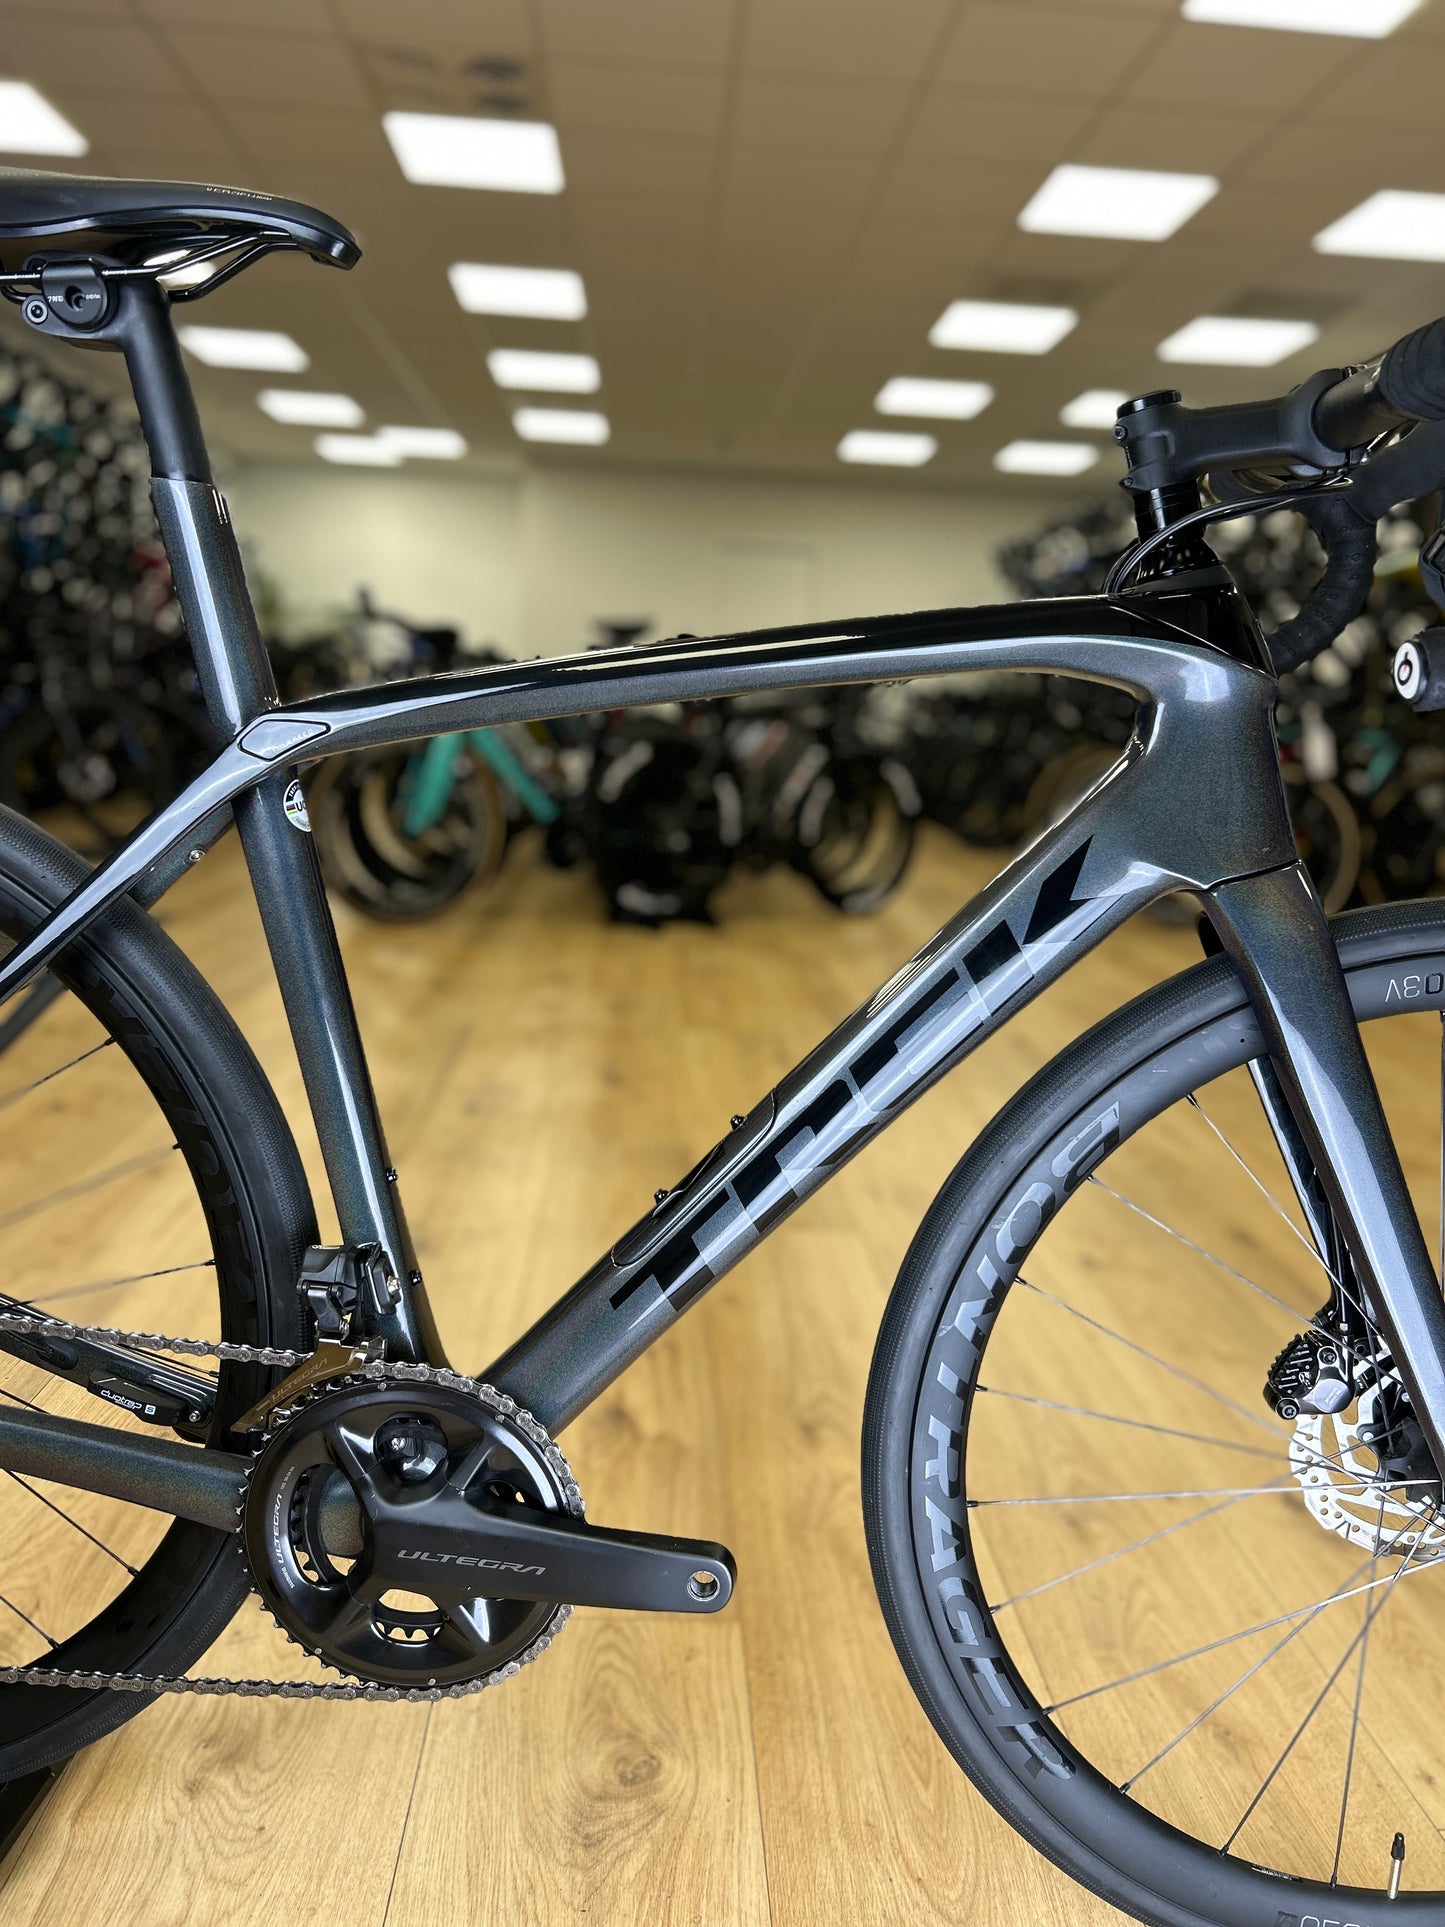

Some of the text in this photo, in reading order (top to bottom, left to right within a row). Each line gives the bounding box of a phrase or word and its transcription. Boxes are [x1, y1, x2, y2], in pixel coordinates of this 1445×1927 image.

[611, 834, 1126, 1312] TREK
[272, 1358, 328, 1401] ULTEGRA
[924, 1100, 1120, 1780] BONTRAGER
[273, 1493, 285, 1564] ULTEGRA
[397, 1549, 546, 1576] ULTEGRA
